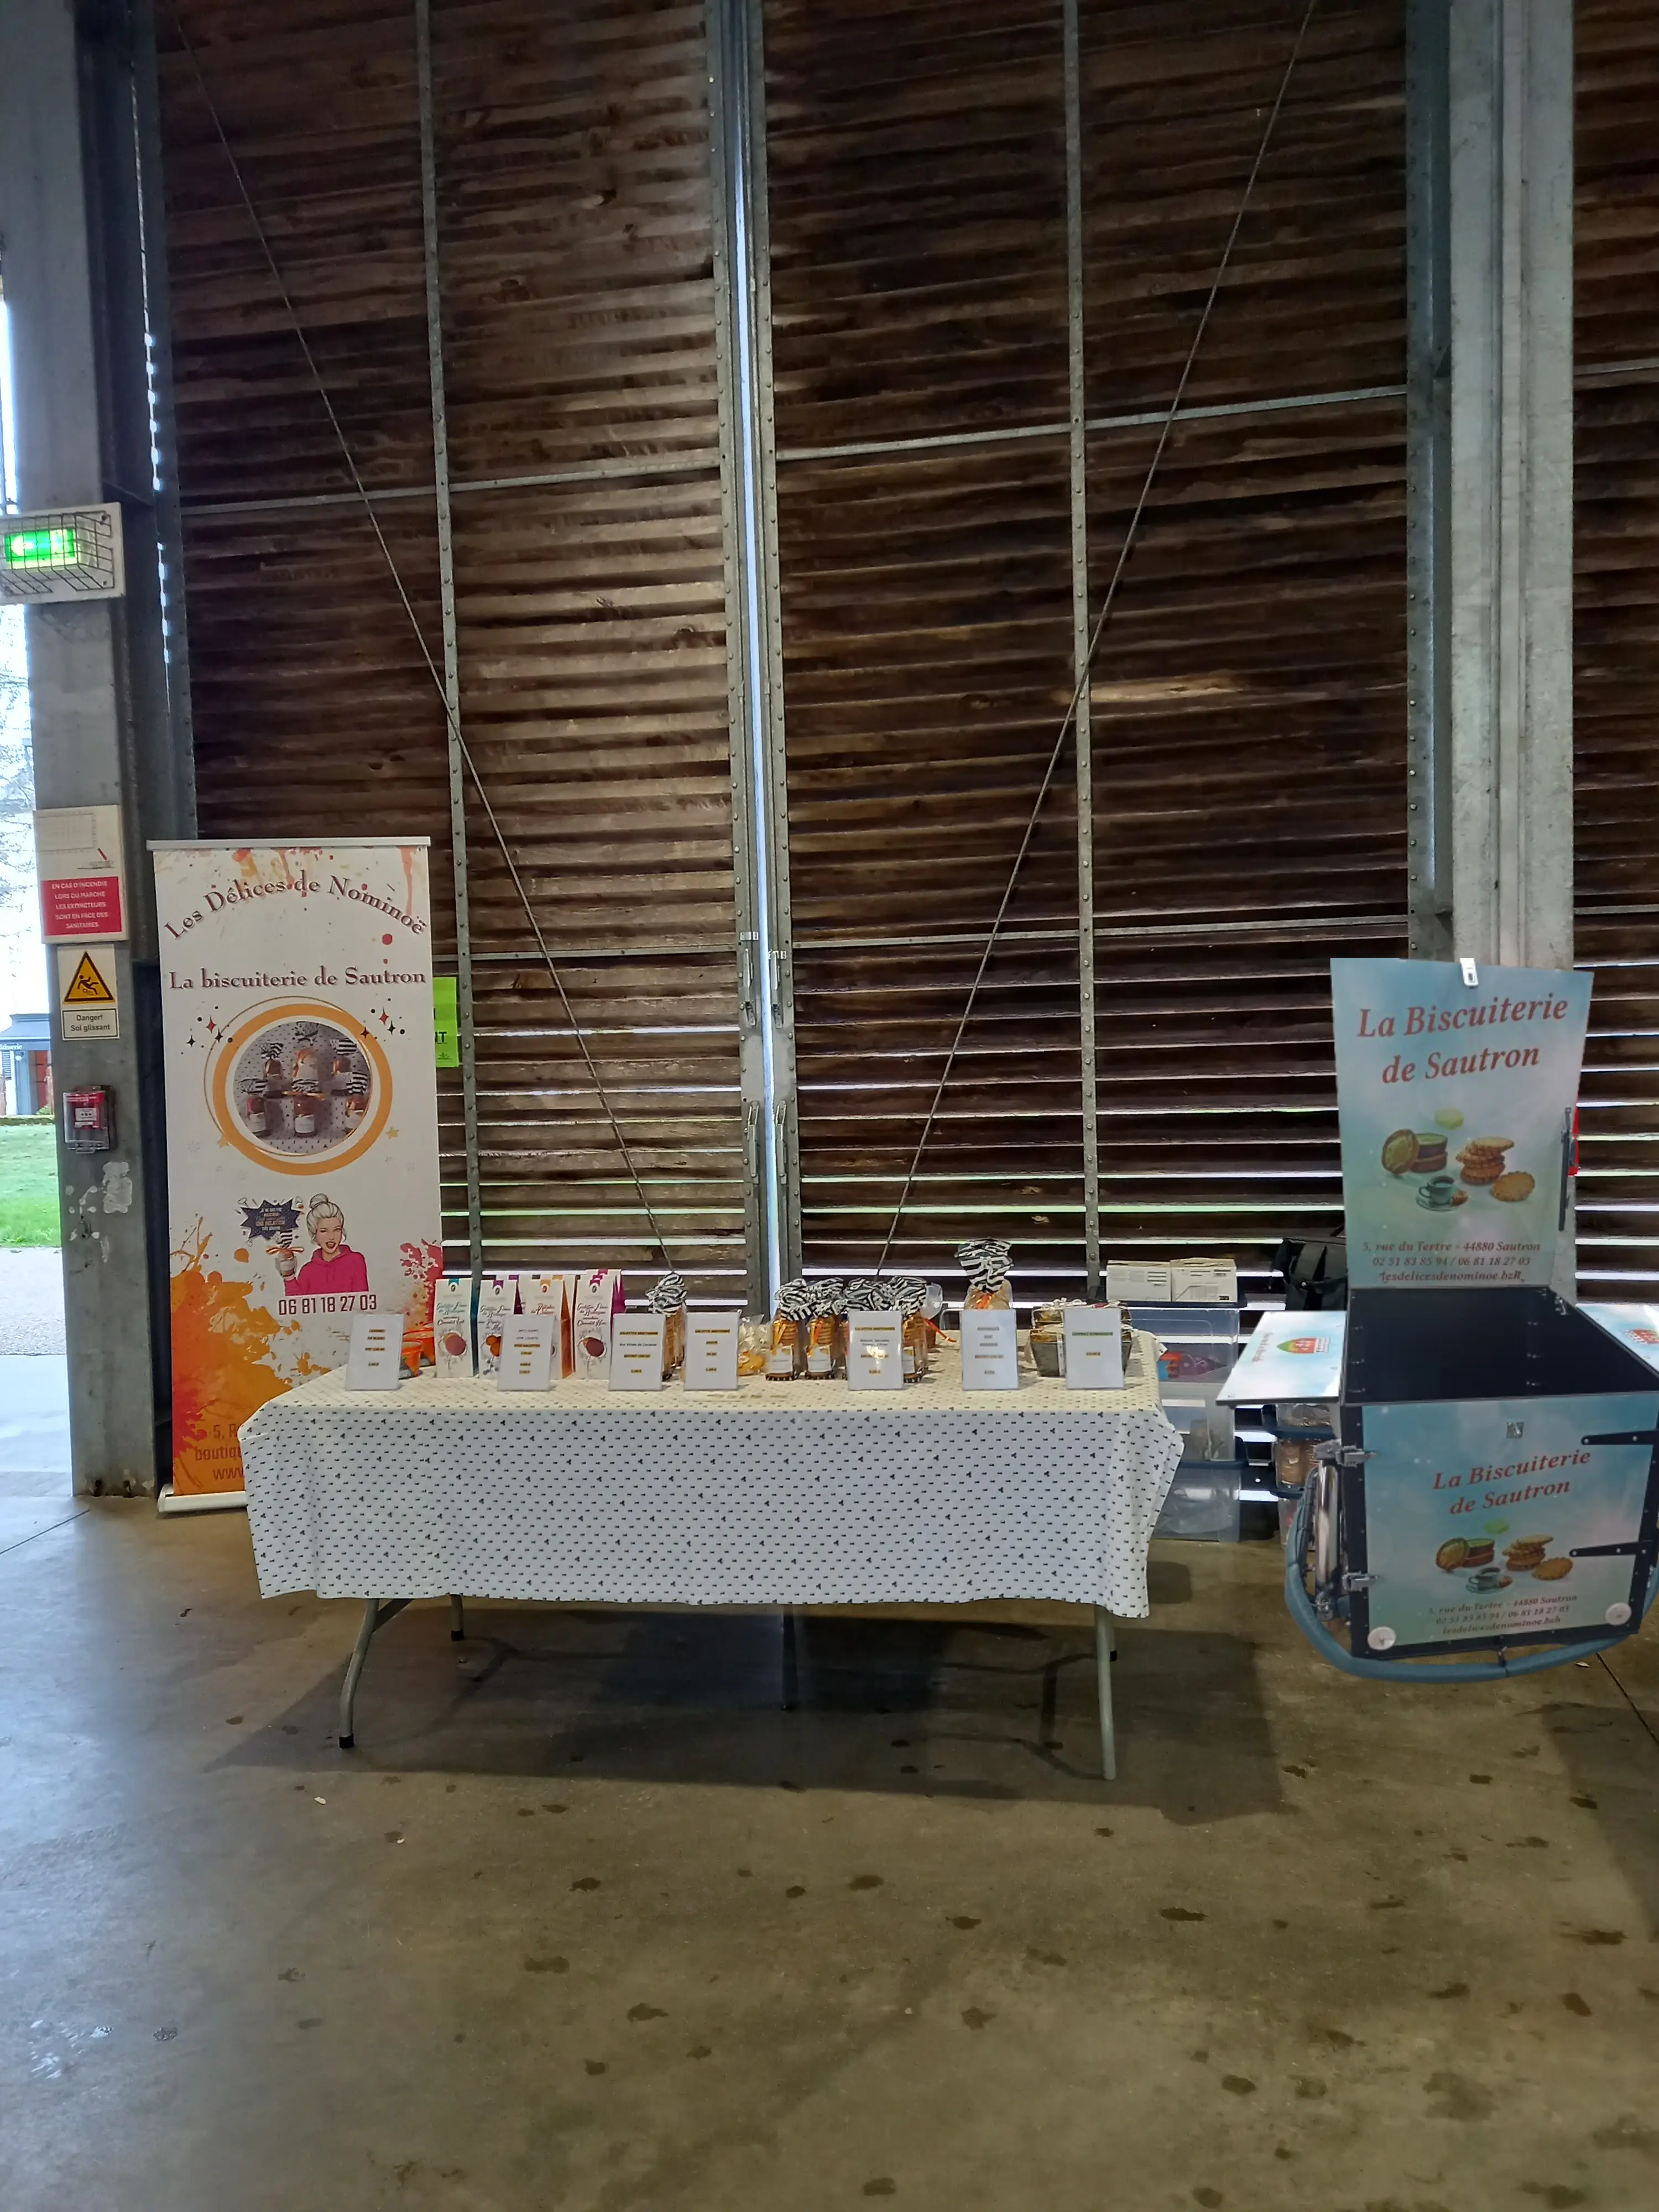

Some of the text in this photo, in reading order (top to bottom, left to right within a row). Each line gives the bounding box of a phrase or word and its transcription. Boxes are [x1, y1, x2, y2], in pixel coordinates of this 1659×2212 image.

[164, 869, 427, 940] Les Délices de Nominoë
[169, 965, 426, 989] La biscuiterie de Sautron
[76, 1014, 103, 1022] Danger!
[1356, 992, 1569, 1038] La Biscuiterie
[83, 1024, 110, 1032] glissant
[1382, 1047, 1540, 1084] de Sautron
[1399, 1241, 1413, 1251] du
[1417, 1240, 1452, 1251] Tertre
[1463, 1241, 1494, 1251] 44880
[1496, 1241, 1541, 1251] Sautron
[1373, 1256, 1385, 1266] 02
[1388, 1256, 1400, 1266] 51
[1404, 1256, 1417, 1266] 83
[1420, 1256, 1432, 1266] 85
[1436, 1256, 1447, 1266] 94
[1458, 1256, 1470, 1266] 06
[1473, 1256, 1484, 1266] 81
[1489, 1256, 1501, 1266] 18
[1503, 1256, 1516, 1266] 27
[1518, 1256, 1531, 1266] 03
[278, 1294, 377, 1316] 06 81 18 27 03
[213, 1423, 238, 1439] 5, R
[1432, 1449, 1591, 1490] La Biscuiterie
[1449, 1480, 1571, 1515] de Sautron
[1458, 1603, 1471, 1612] du
[1540, 1595, 1578, 1604] Sautron
